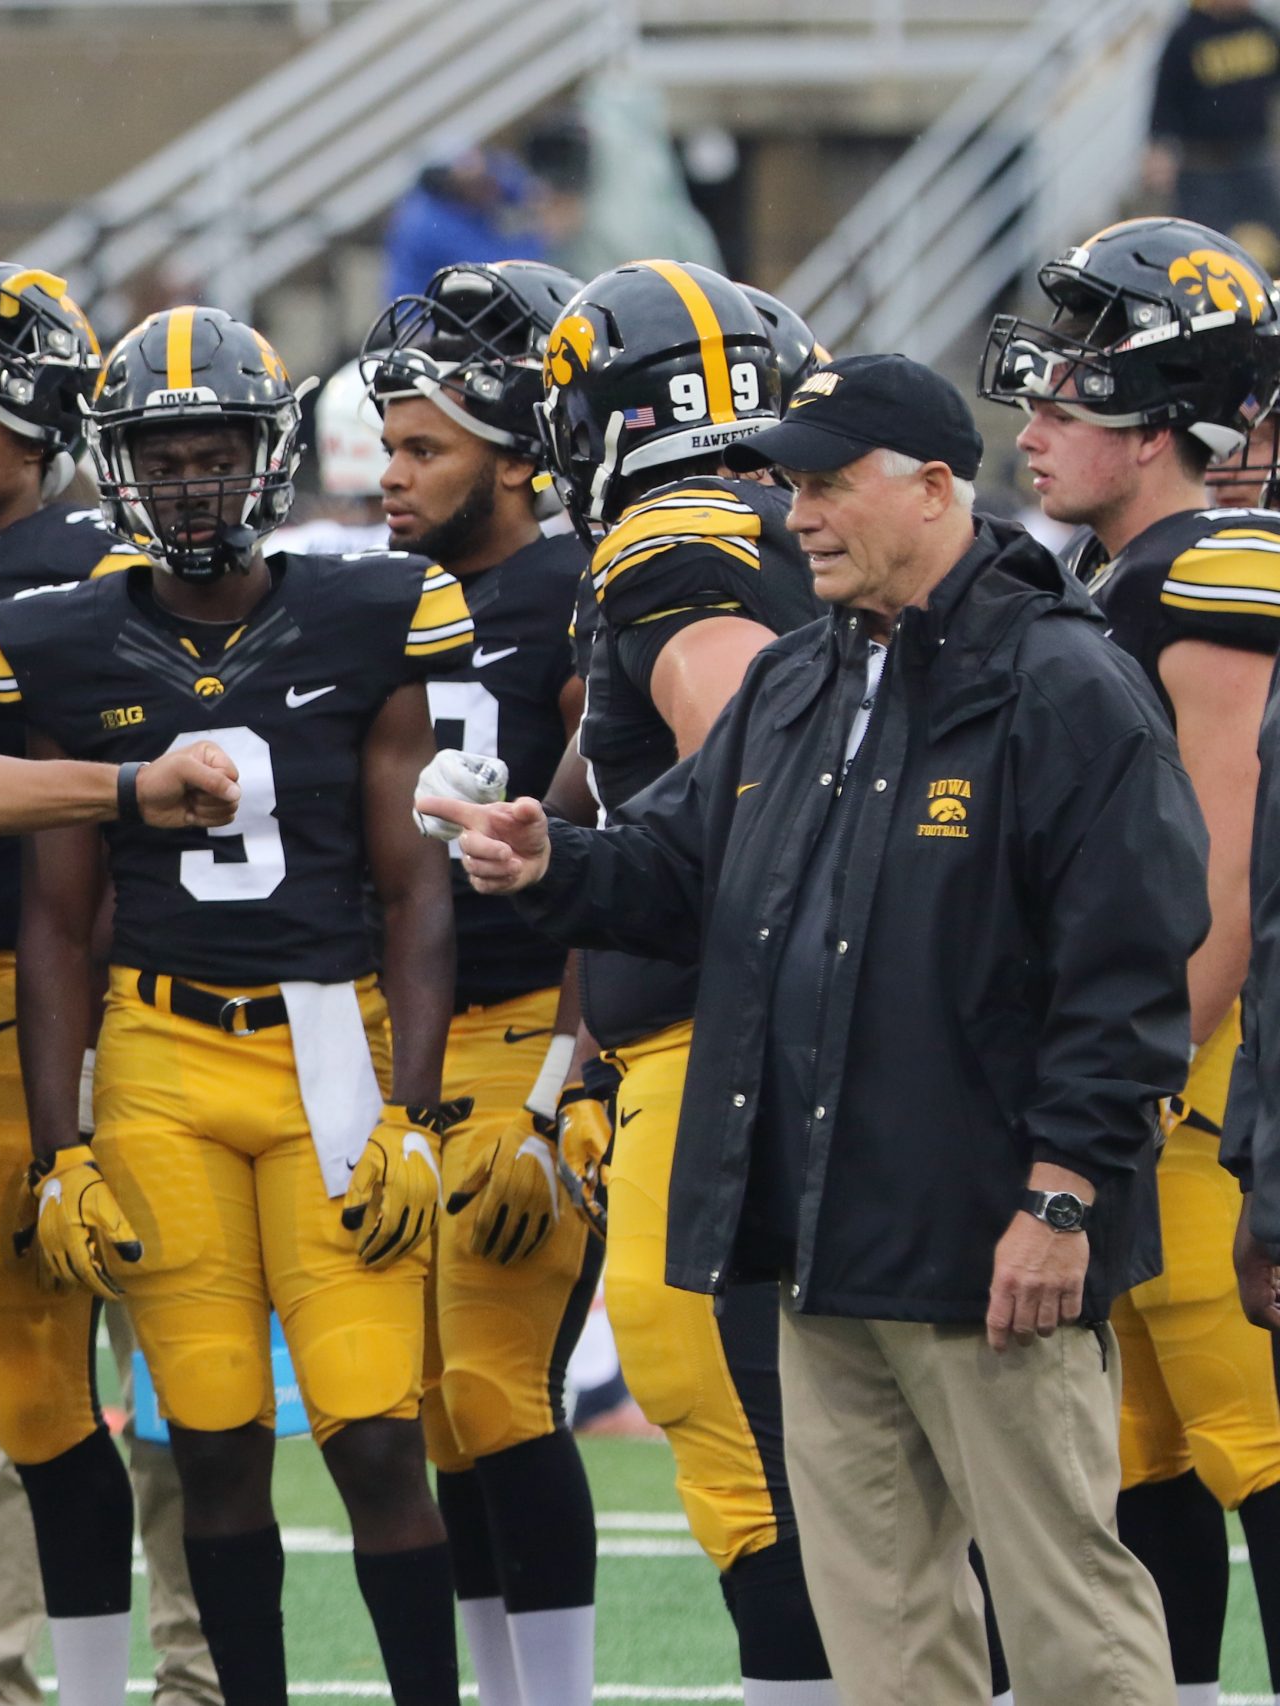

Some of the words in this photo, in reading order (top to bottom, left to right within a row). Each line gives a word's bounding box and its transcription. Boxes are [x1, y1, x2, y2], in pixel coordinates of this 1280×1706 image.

[159, 391, 201, 405] IOWA
[927, 779, 972, 798] IOWA
[917, 824, 970, 838] FOOTBALL
